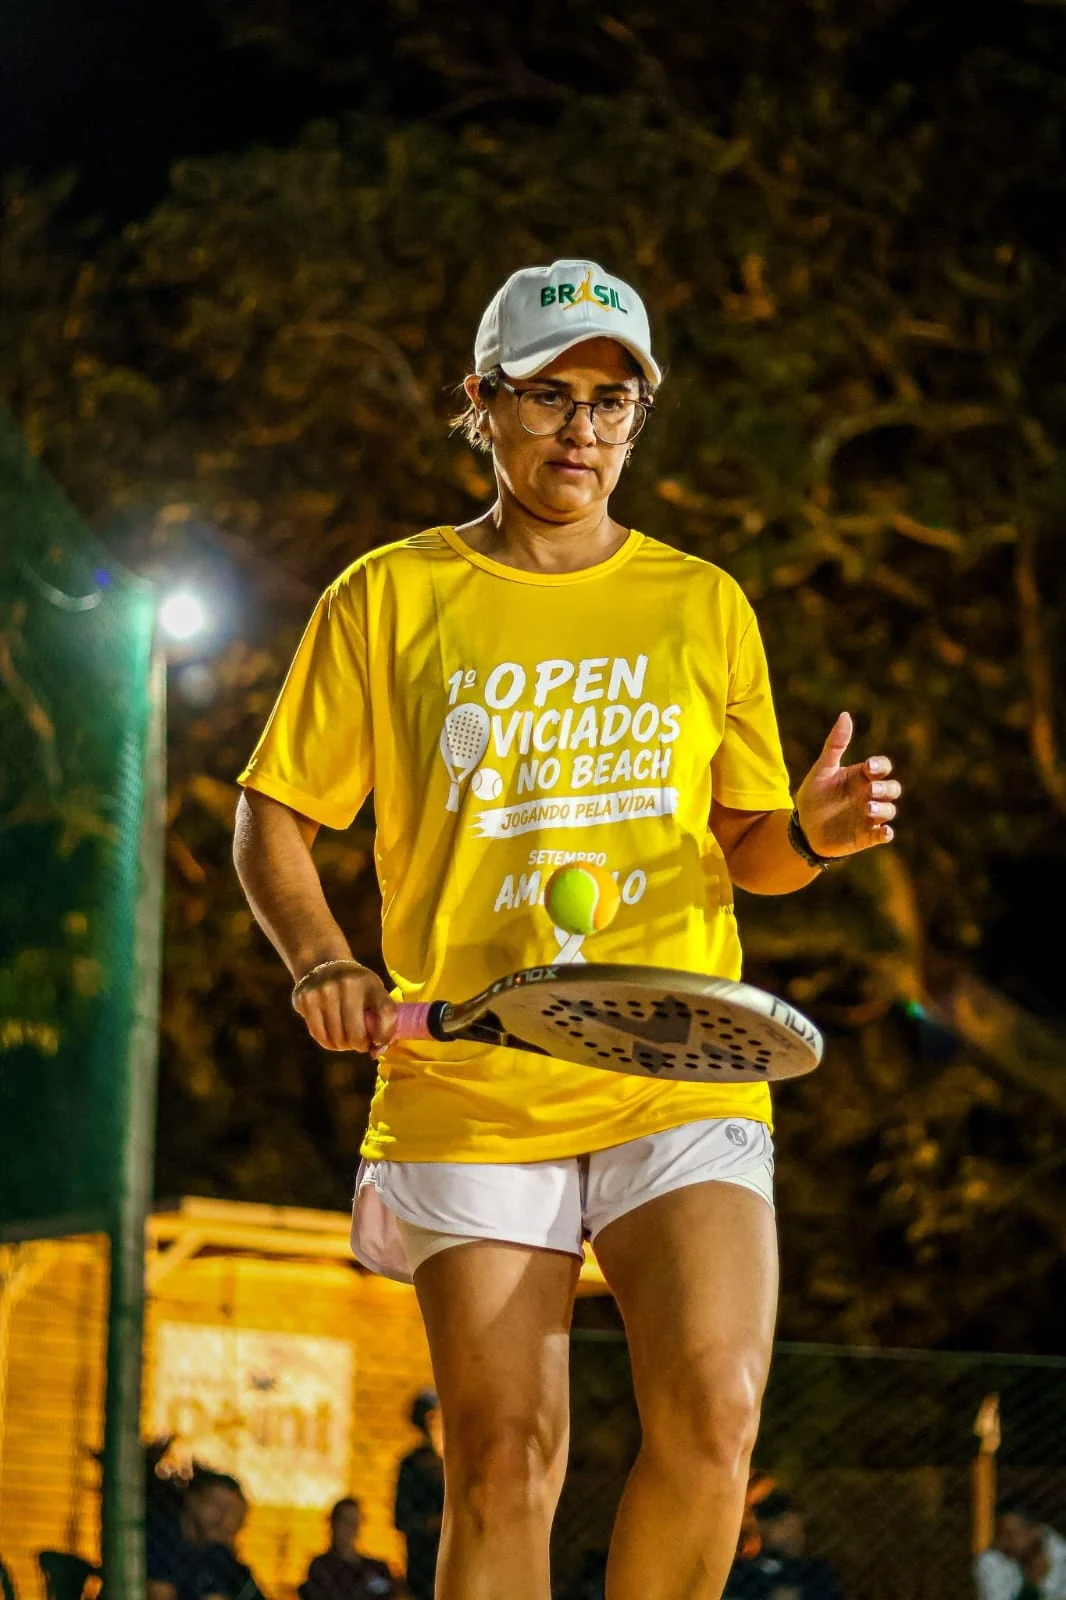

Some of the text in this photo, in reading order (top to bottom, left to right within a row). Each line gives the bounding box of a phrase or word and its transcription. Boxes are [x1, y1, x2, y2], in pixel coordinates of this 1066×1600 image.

[448, 654, 648, 709] 1º OPEN
[492, 702, 681, 757] VICIADOS
[517, 748, 672, 794] NO BEACH
[501, 795, 656, 830] JOGANDO PELA VIDA
